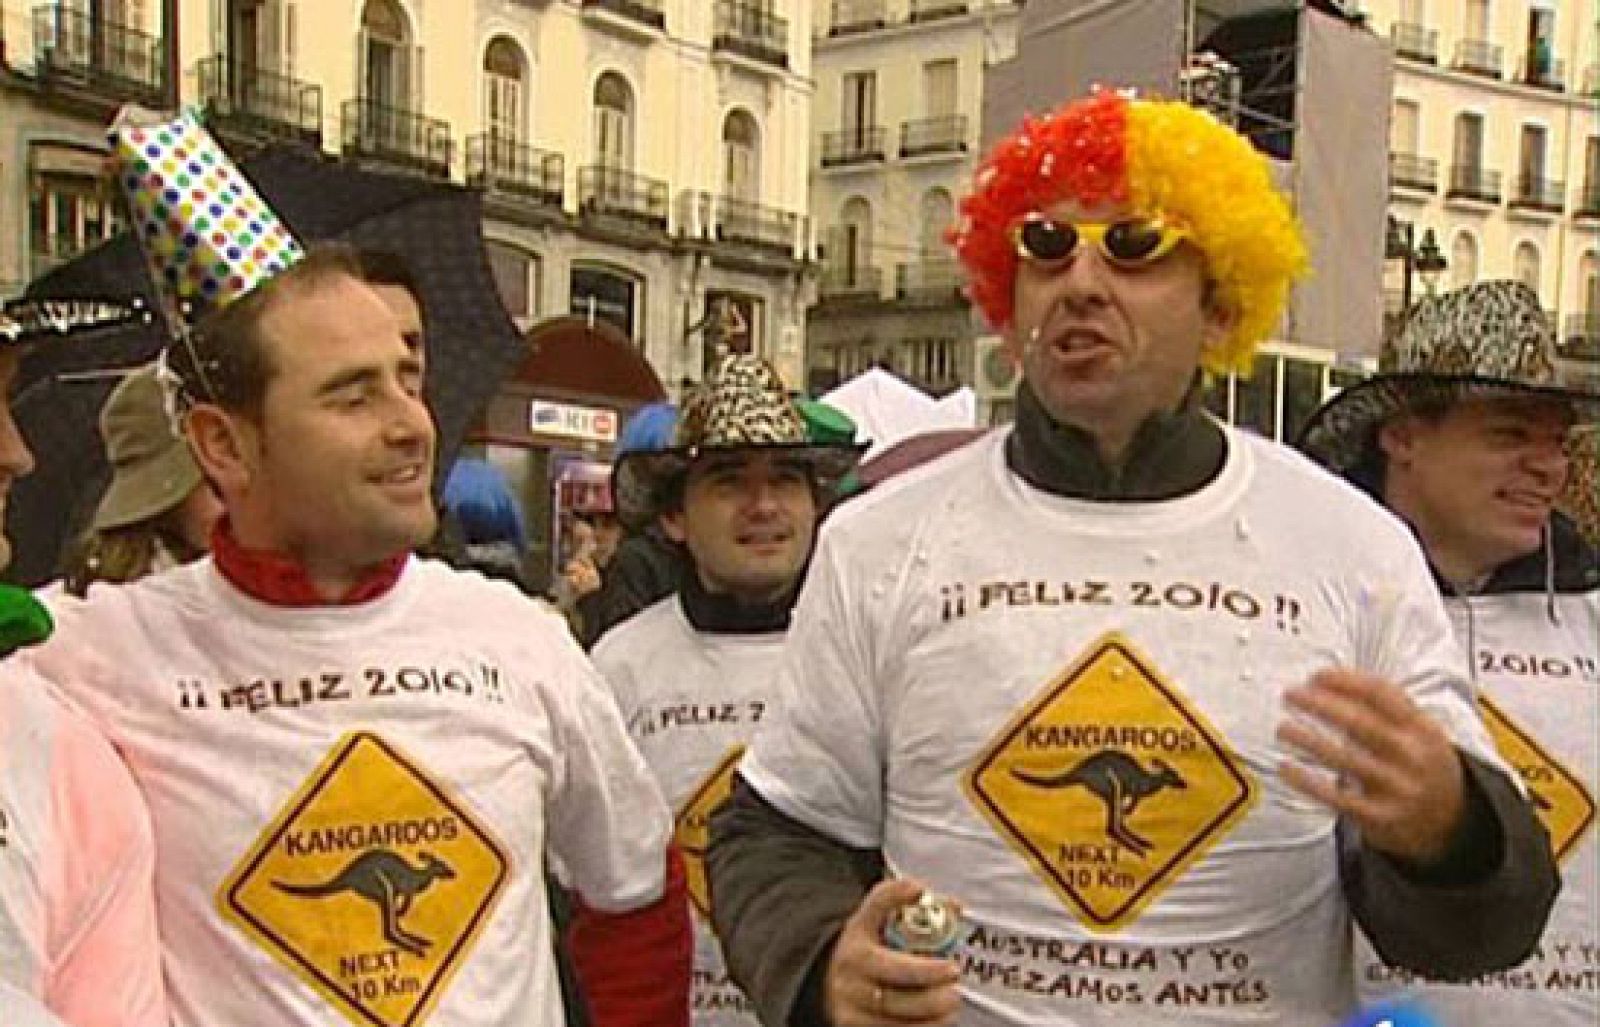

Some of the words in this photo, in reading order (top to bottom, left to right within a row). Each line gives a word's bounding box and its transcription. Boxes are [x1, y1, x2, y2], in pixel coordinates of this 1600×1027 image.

[979, 580, 1112, 609] FELIZ
[1130, 581, 1262, 619] 2010
[1479, 651, 1571, 678] 2010
[220, 673, 350, 713] FELIZ
[364, 667, 473, 696] 2010
[660, 703, 740, 729] FELIZ
[1025, 726, 1197, 752] KANGAROOS
[285, 818, 459, 856] KANGAROOS
[1058, 844, 1120, 865] NEXT
[1066, 869, 1092, 890] 10
[1098, 870, 1136, 890] Km
[966, 926, 1158, 972] AUSTRALIA
[1171, 948, 1195, 973] Y
[339, 951, 402, 978] NEXT
[383, 973, 421, 996] Km
